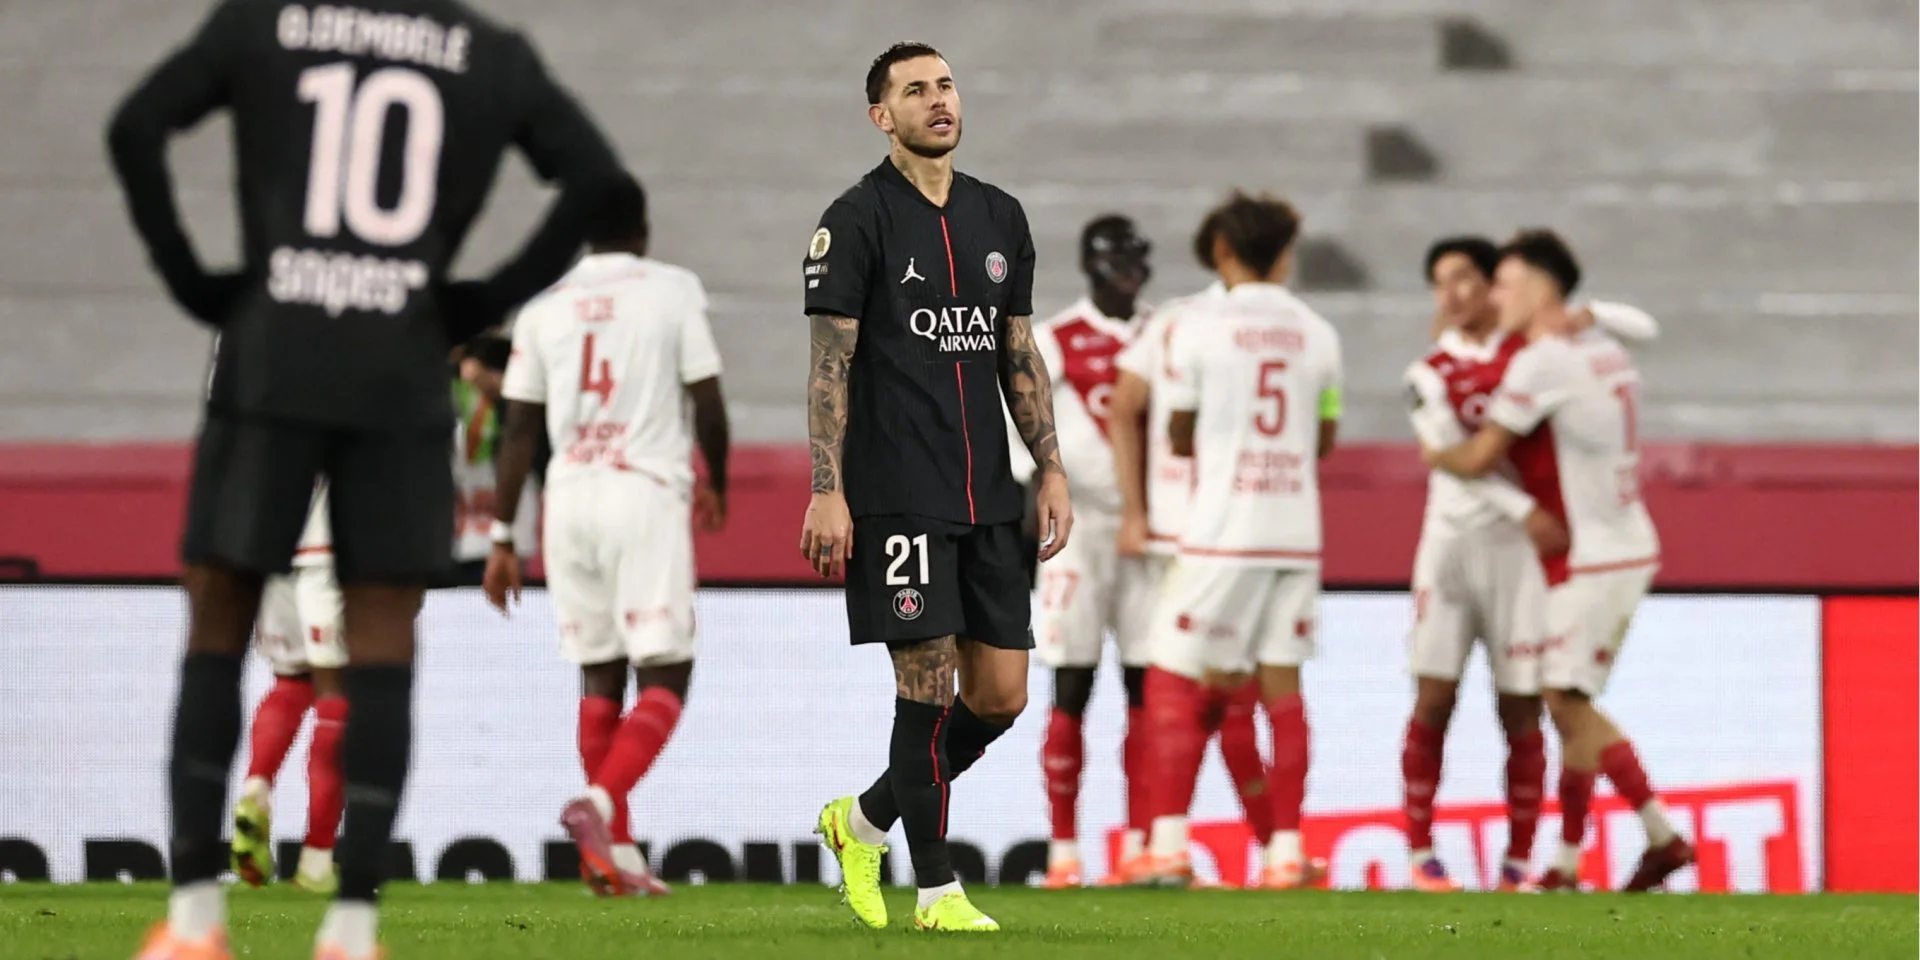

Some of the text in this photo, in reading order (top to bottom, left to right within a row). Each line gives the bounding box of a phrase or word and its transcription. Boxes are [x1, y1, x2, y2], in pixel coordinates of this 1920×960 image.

[297, 62, 444, 246] 10
[580, 332, 617, 407] 4
[1255, 360, 1287, 437] 5
[885, 533, 929, 586] 21
